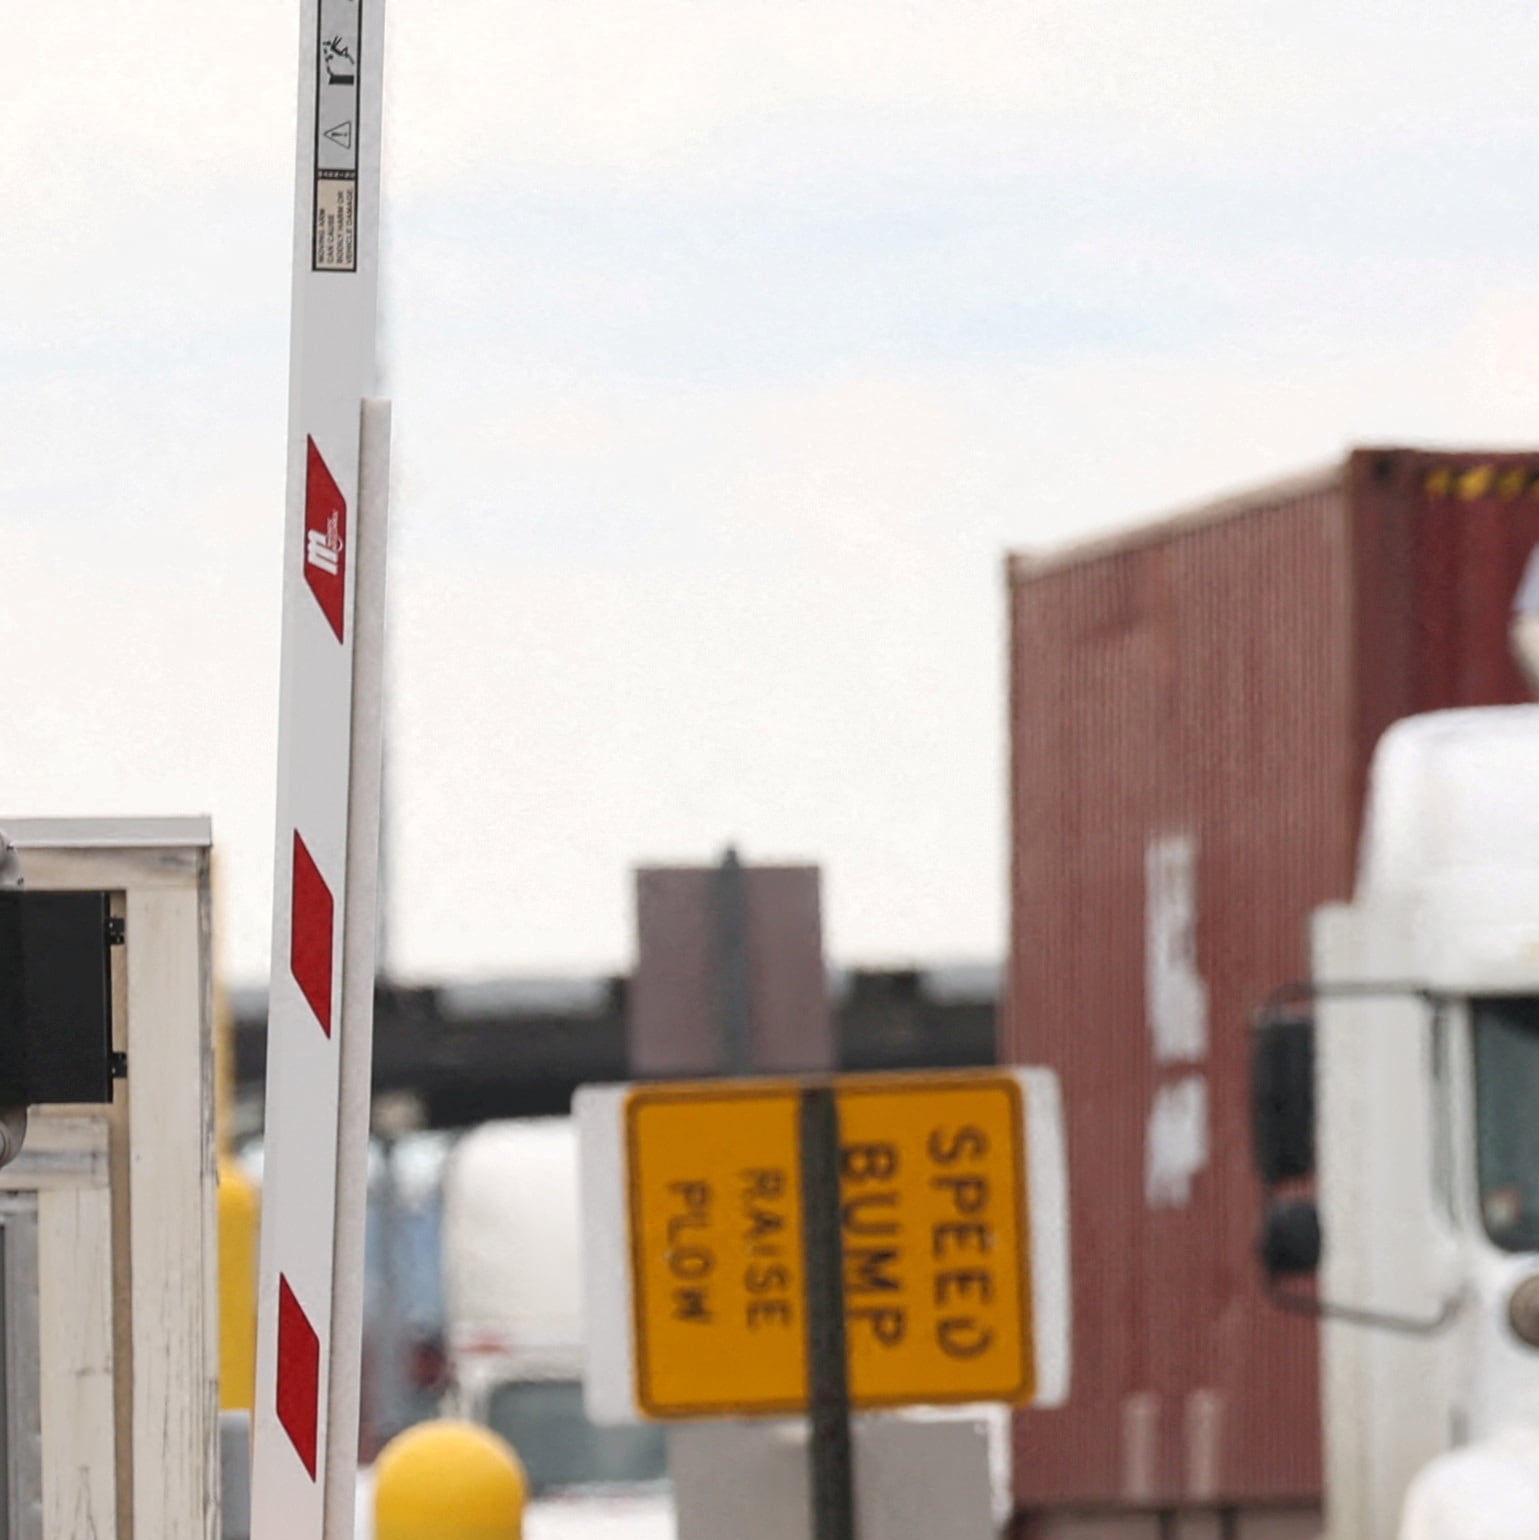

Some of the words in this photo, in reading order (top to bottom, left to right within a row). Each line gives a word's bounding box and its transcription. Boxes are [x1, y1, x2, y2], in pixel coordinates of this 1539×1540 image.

[667, 1180, 713, 1324] PLOW
[739, 1168, 789, 1330] RAISE
[841, 1142, 906, 1347] BUMP
[928, 1124, 995, 1358] SPEED
